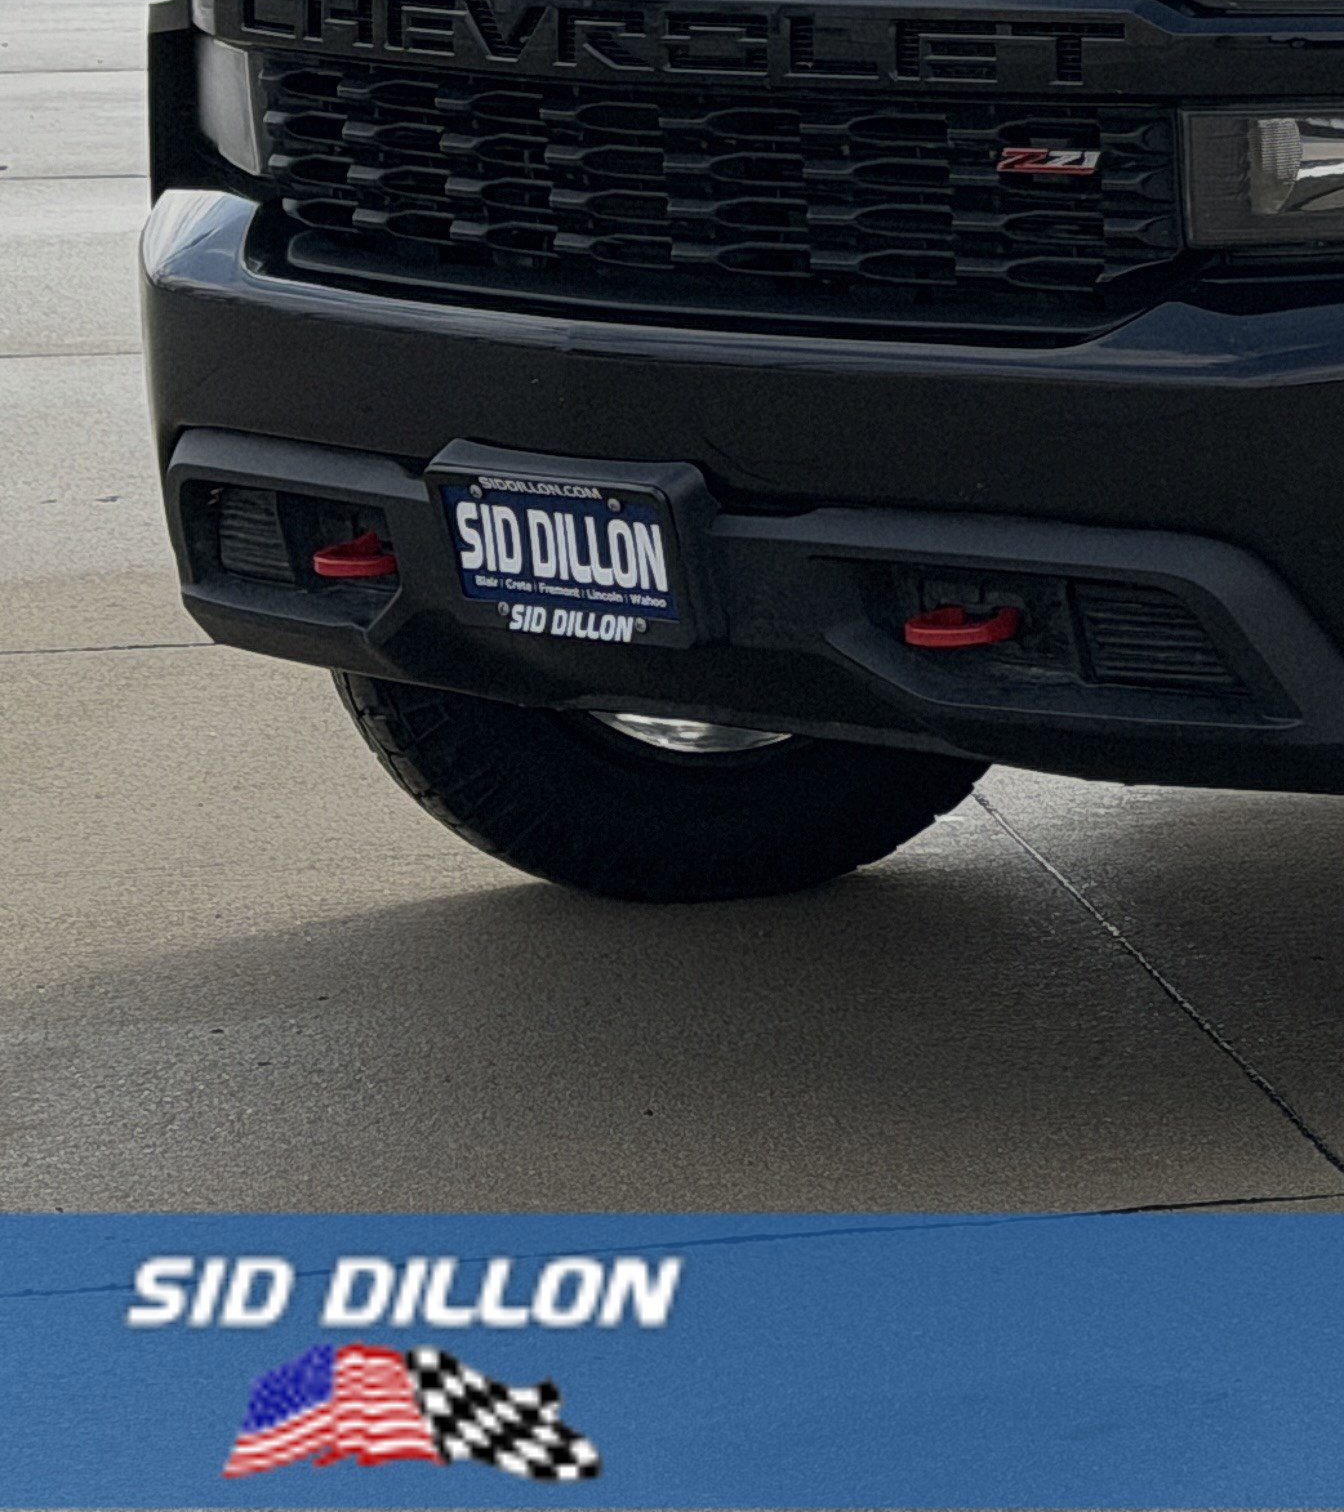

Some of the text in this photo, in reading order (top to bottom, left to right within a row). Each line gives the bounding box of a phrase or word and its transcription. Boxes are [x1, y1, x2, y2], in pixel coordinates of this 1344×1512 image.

[996, 147, 1101, 176] Z71
[478, 477, 602, 499] SIDDILLON.COM
[456, 501, 668, 592] SID DILLON
[475, 575, 498, 587] Blair
[537, 582, 580, 599] Fremont
[586, 589, 622, 604] Lincoln
[630, 594, 667, 608] Wahoo
[509, 604, 634, 643] SID DILLON
